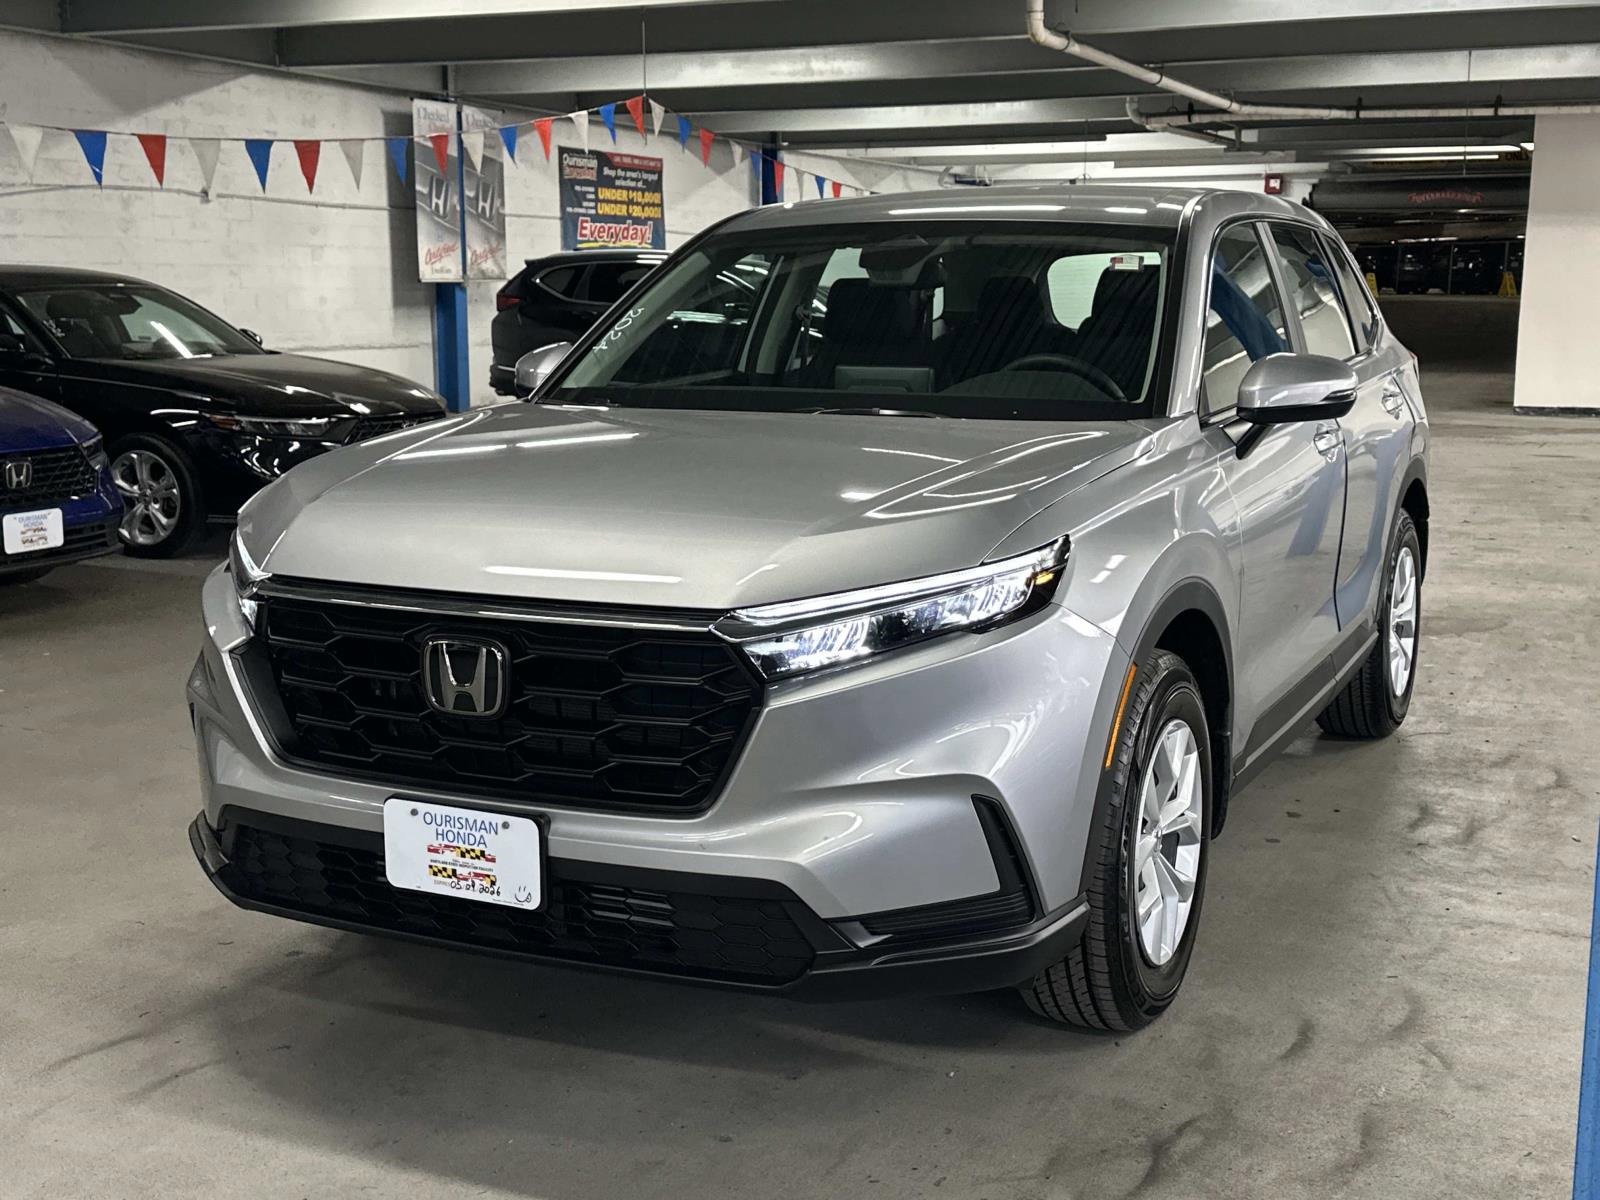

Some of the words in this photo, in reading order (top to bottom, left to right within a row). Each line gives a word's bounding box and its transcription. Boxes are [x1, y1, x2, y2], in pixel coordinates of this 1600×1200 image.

[563, 153, 598, 168] Ourisman
[597, 187, 628, 201] UNDER
[597, 202, 628, 216] UNDER
[577, 217, 653, 245] Everyday!
[423, 811, 499, 836] OURISMAN
[435, 828, 488, 848] HONDA
